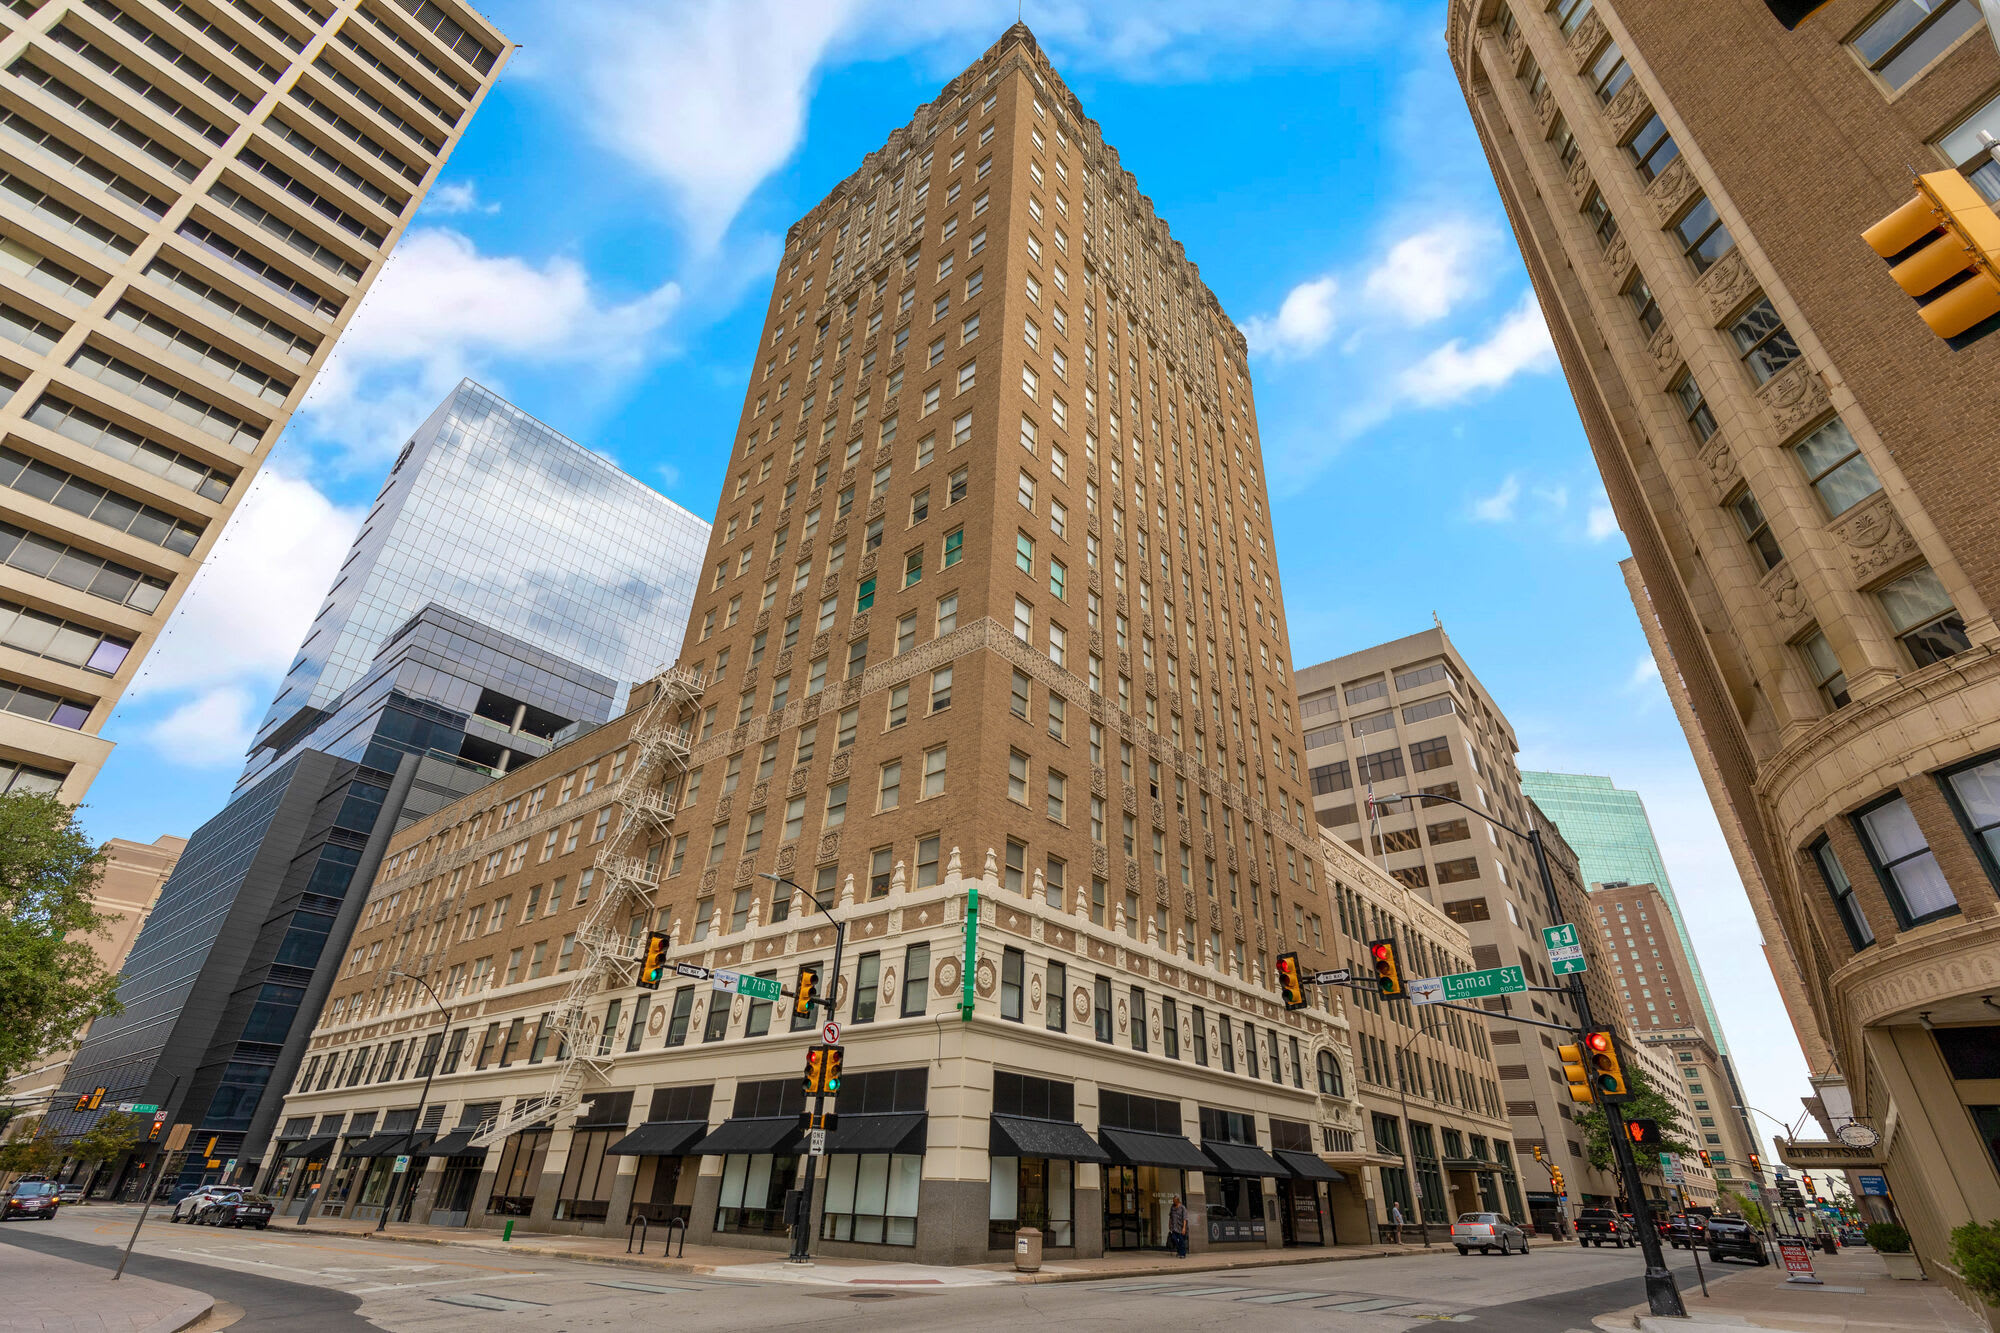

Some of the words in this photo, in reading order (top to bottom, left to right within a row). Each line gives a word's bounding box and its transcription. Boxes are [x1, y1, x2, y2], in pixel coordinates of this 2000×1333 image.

[741, 976, 749, 988] W
[752, 978, 767, 992] 7th
[770, 982, 779, 995] St
[1446, 974, 1492, 991] Lamar
[1500, 968, 1518, 984] St
[812, 1131, 824, 1139] ONE
